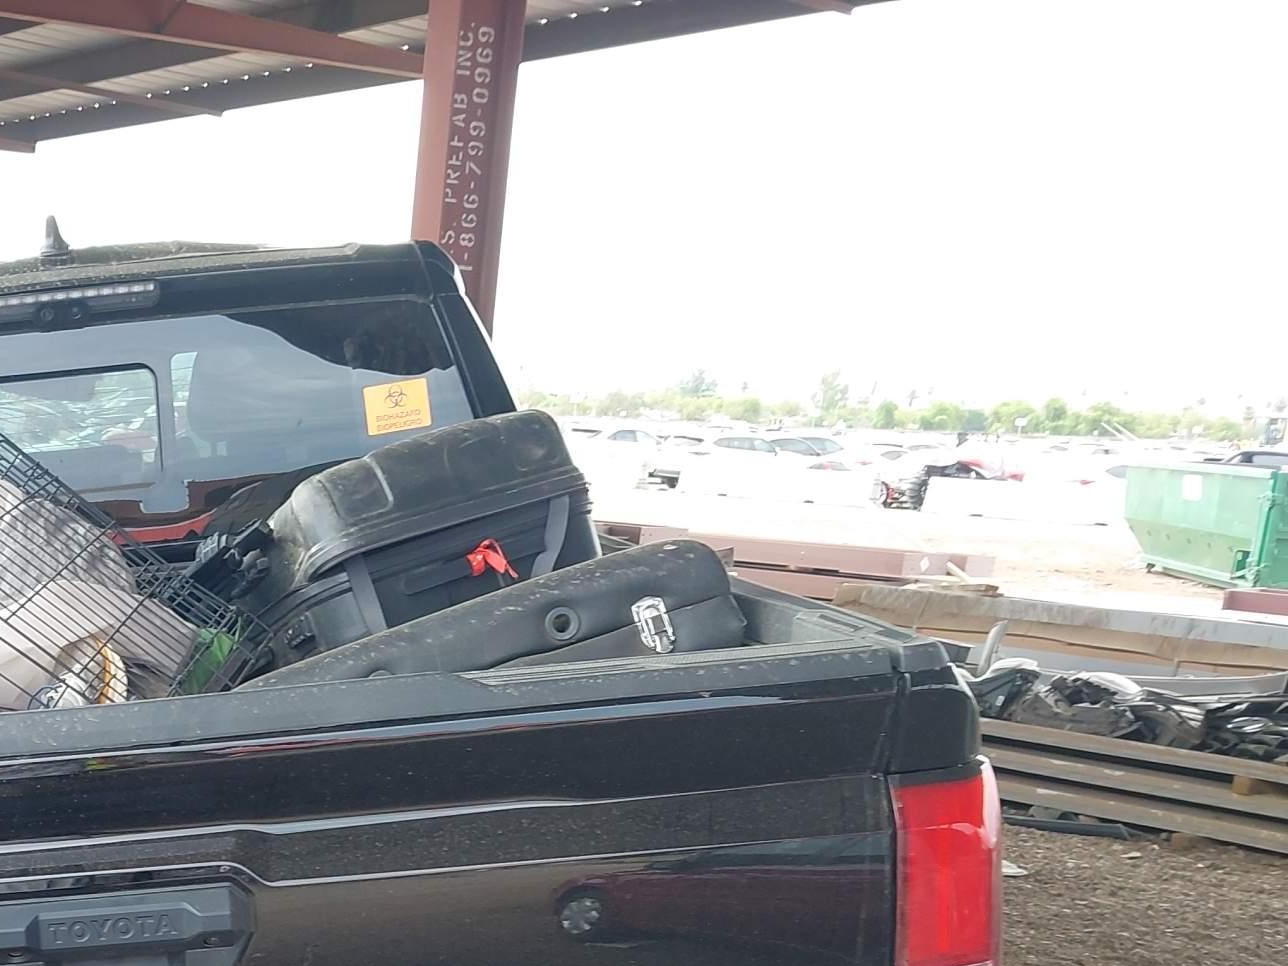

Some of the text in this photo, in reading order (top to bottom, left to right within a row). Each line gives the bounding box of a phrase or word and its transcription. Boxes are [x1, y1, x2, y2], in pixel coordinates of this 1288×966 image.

[455, 21, 475, 77] INC.
[444, 92, 468, 204] PREFAB
[459, 26, 496, 271] 1-866-799-0969
[47, 913, 179, 944] TOYOTA
